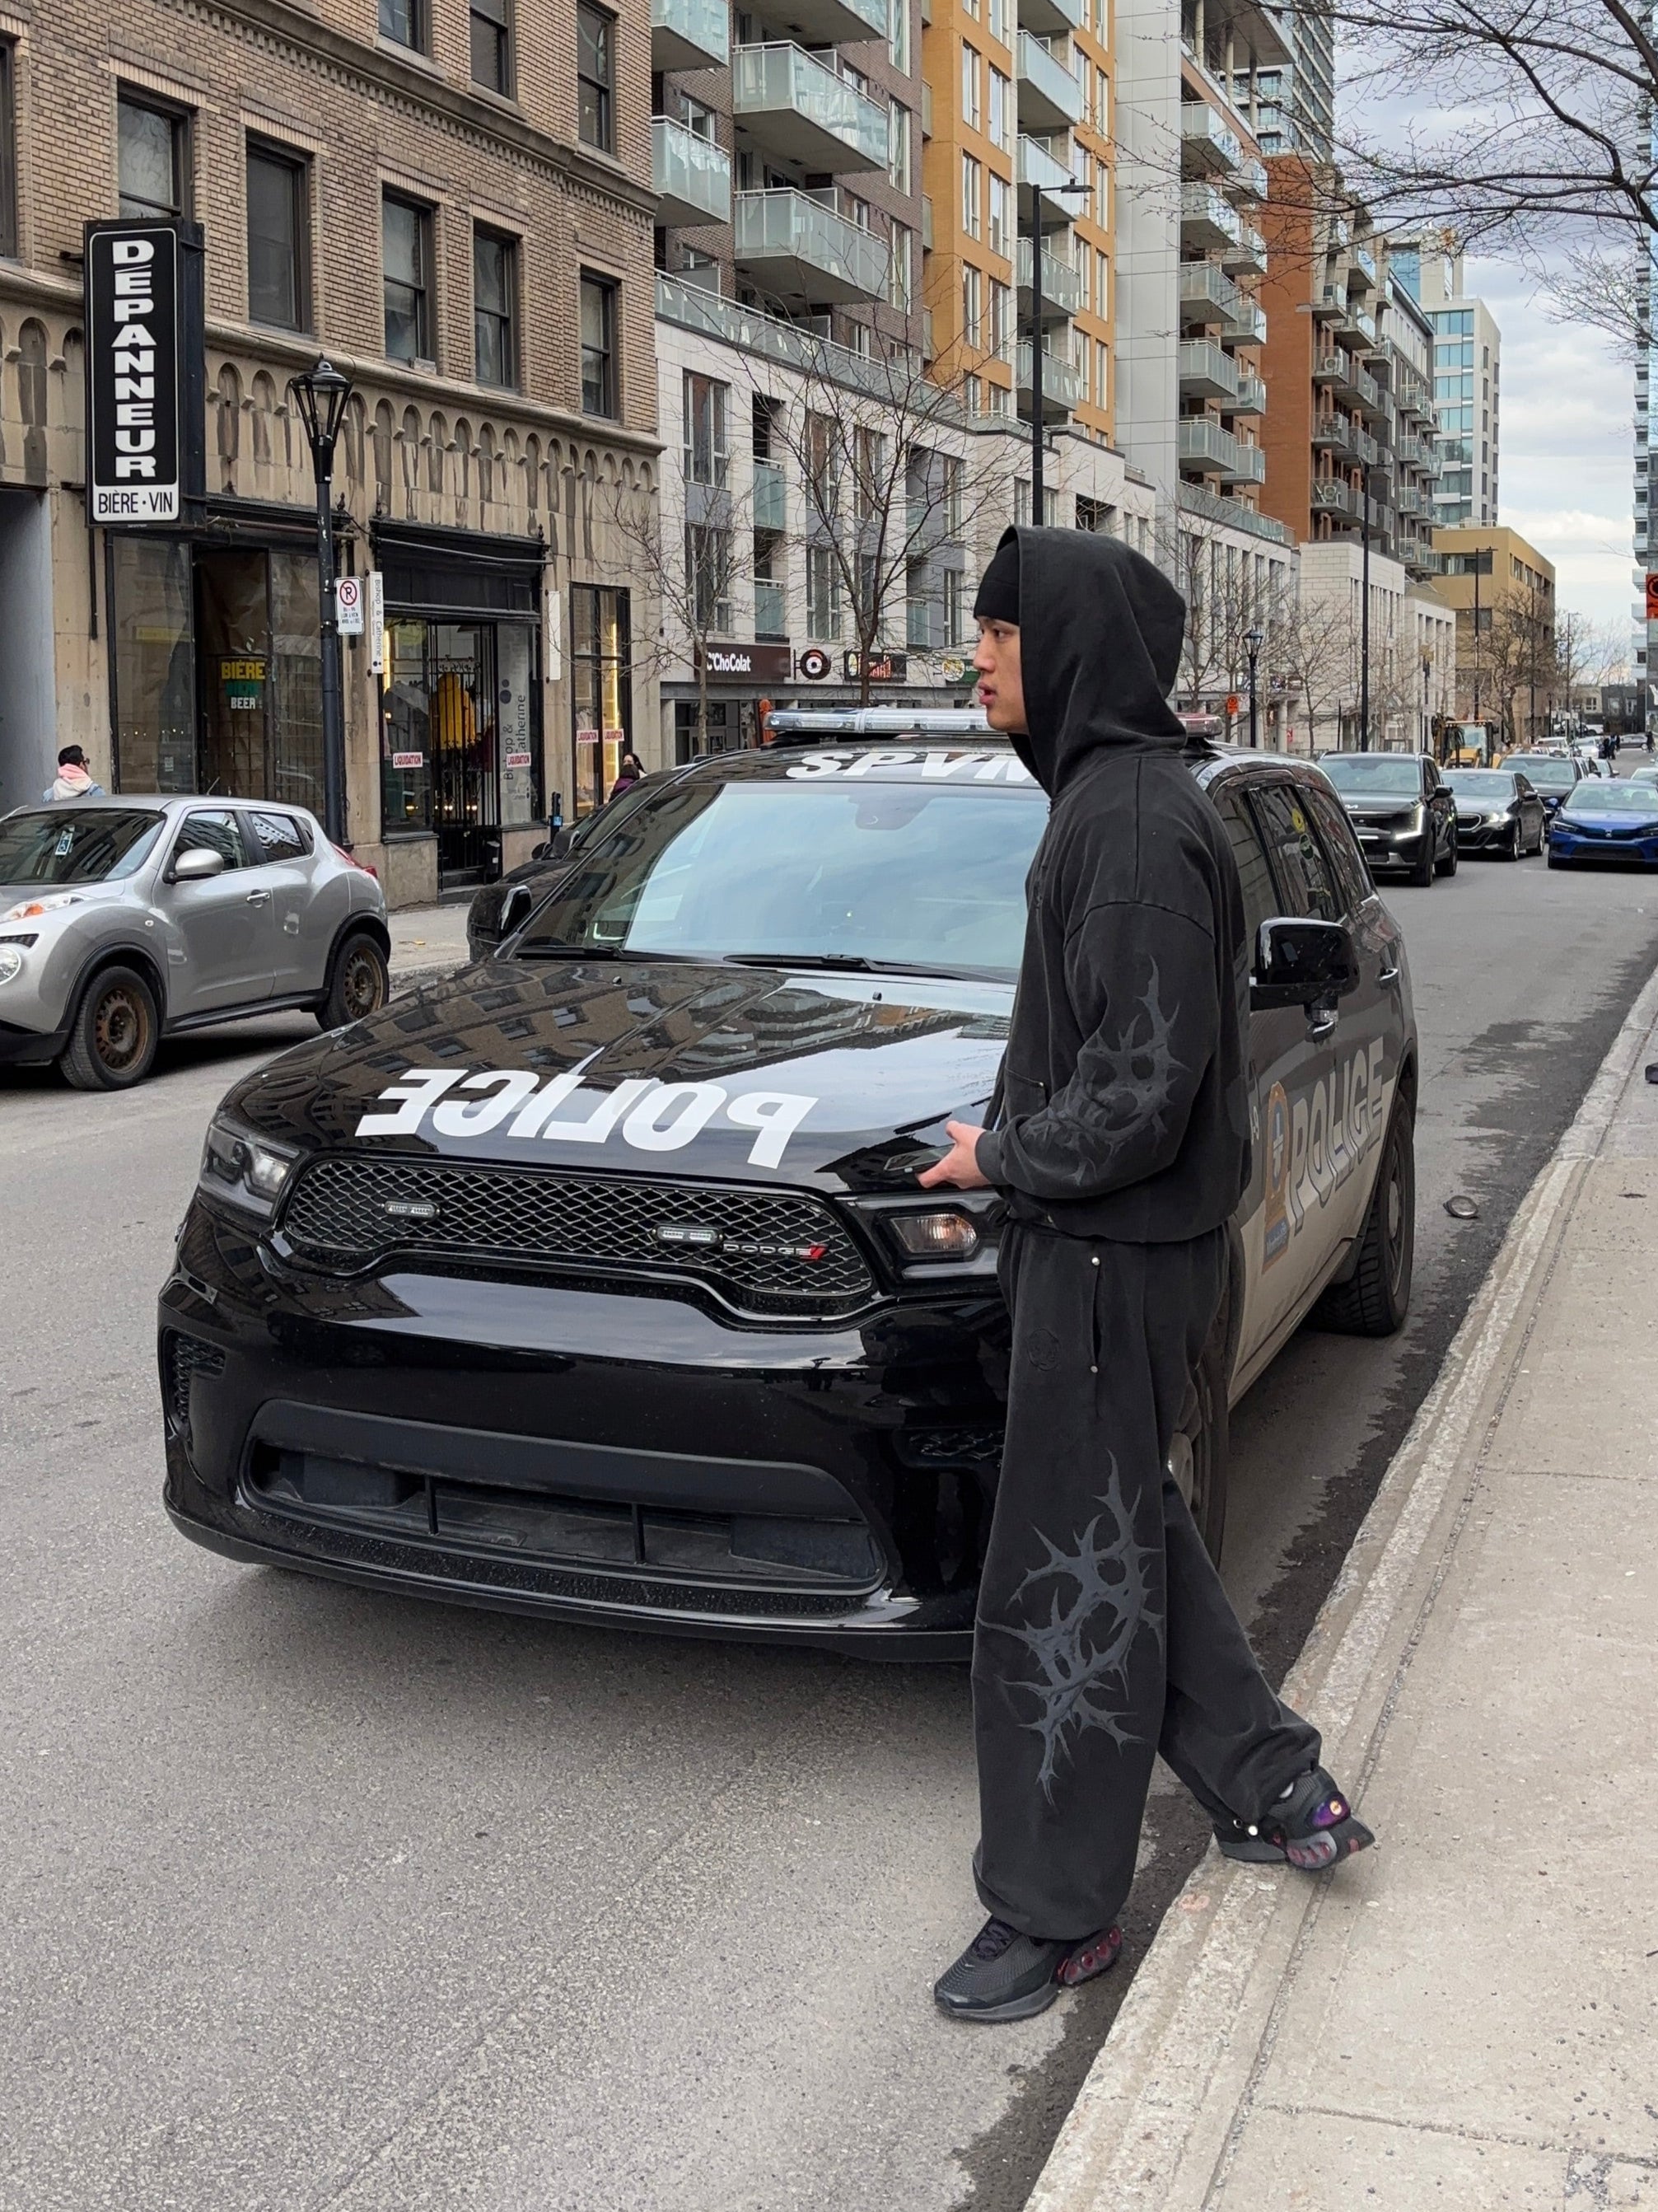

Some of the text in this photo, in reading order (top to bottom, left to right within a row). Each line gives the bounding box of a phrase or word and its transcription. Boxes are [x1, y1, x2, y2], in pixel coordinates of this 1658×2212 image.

[111, 239, 157, 478] DÉPANNEUR
[98, 489, 172, 513] BIÈRE VIN
[221, 659, 265, 680] BIÈRE
[231, 697, 255, 709] BEER
[578, 732, 597, 741] LIQUIDATION
[605, 731, 623, 740] LIQUIDATION
[502, 724, 515, 780] Biop &
[395, 754, 422, 765] LIQUIDATION
[507, 754, 530, 765] LIQUIDATION
[1289, 1036, 1384, 1237] POLICE
[723, 1243, 812, 1256] DODGE
